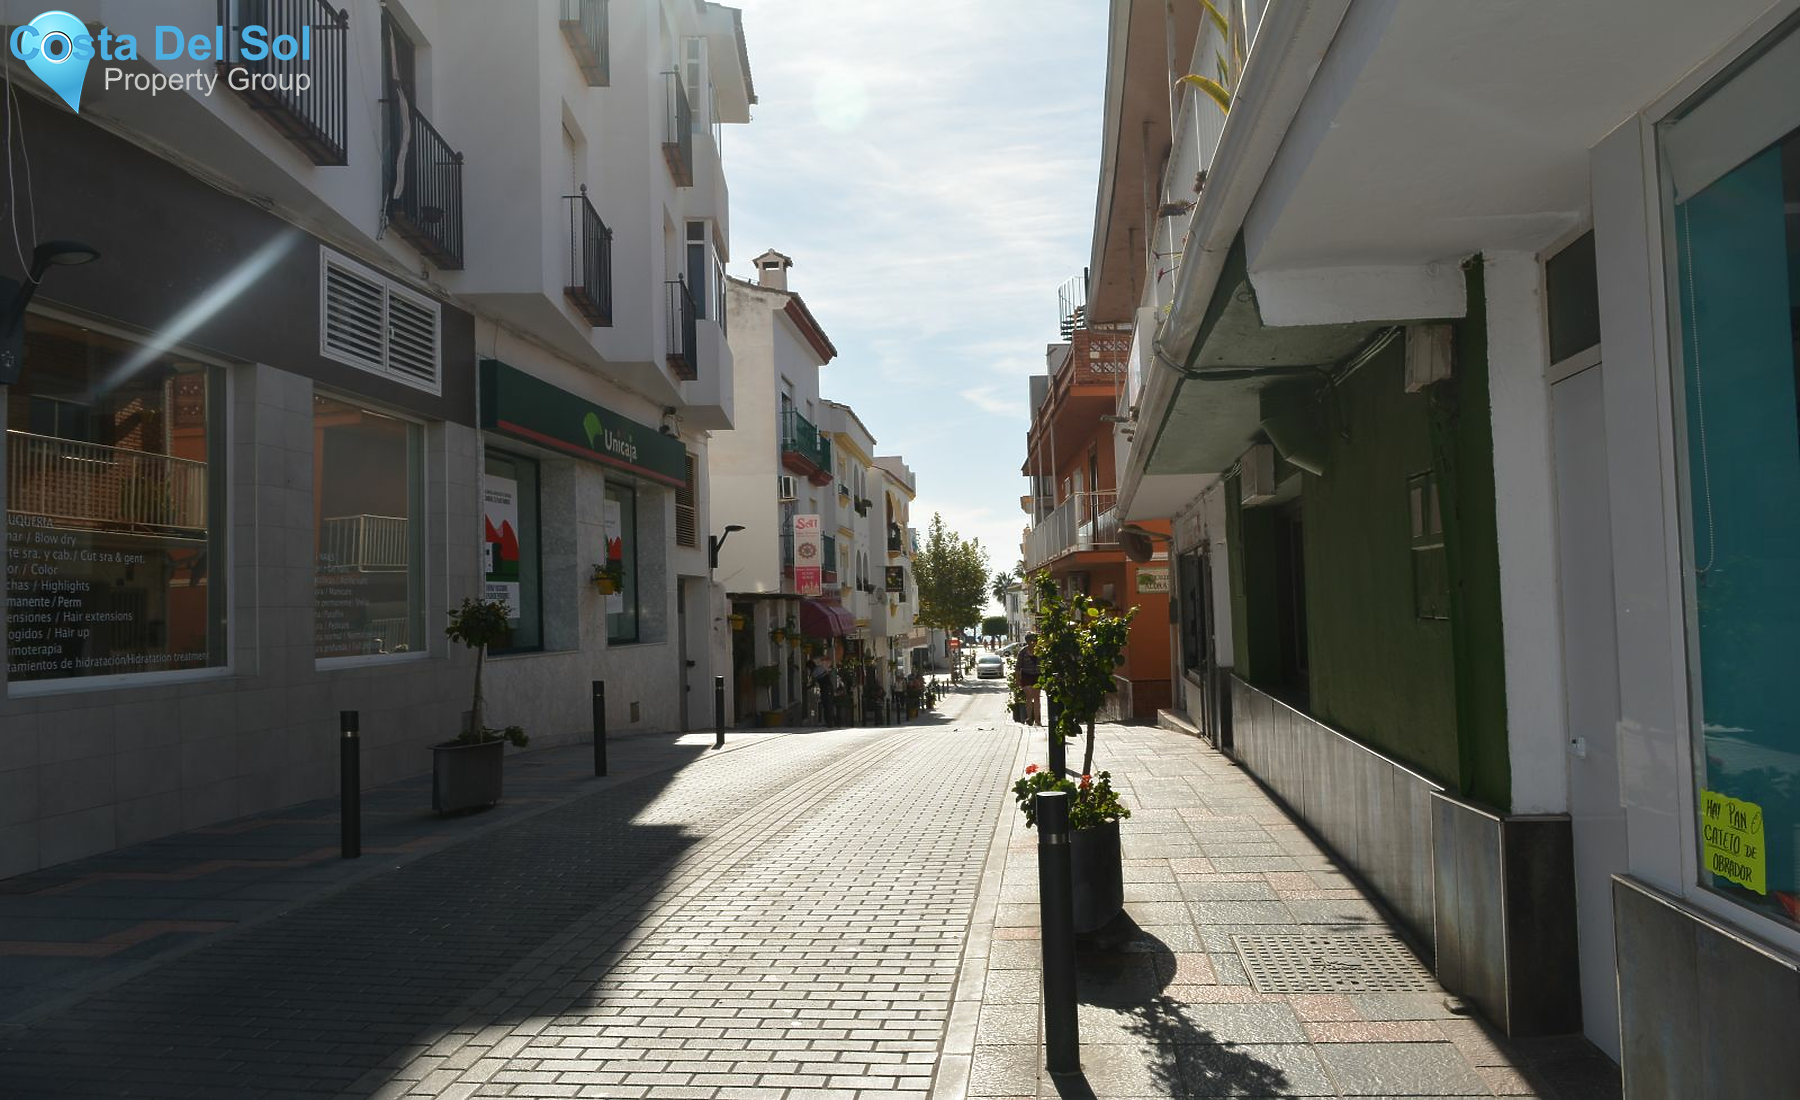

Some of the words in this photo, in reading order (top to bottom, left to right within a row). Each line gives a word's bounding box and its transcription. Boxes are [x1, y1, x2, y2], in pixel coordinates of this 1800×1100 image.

[604, 429, 637, 463] Unicaja
[36, 532, 59, 545] Blow
[61, 534, 77, 548] dry
[44, 551, 51, 562] y
[81, 550, 98, 562] Cut
[116, 552, 123, 563] &
[31, 563, 59, 575] Color
[41, 579, 90, 594] Highlights
[64, 611, 83, 622] Hair
[85, 610, 133, 623] extensions
[55, 627, 75, 639] Hair
[77, 628, 90, 640] up
[61, 657, 73, 669] de
[1706, 799, 1721, 820] HAY
[1727, 802, 1747, 829] PAN
[1704, 824, 1741, 855] CATETO
[1745, 844, 1757, 859] DE
[1712, 852, 1753, 882] OBRADOR
